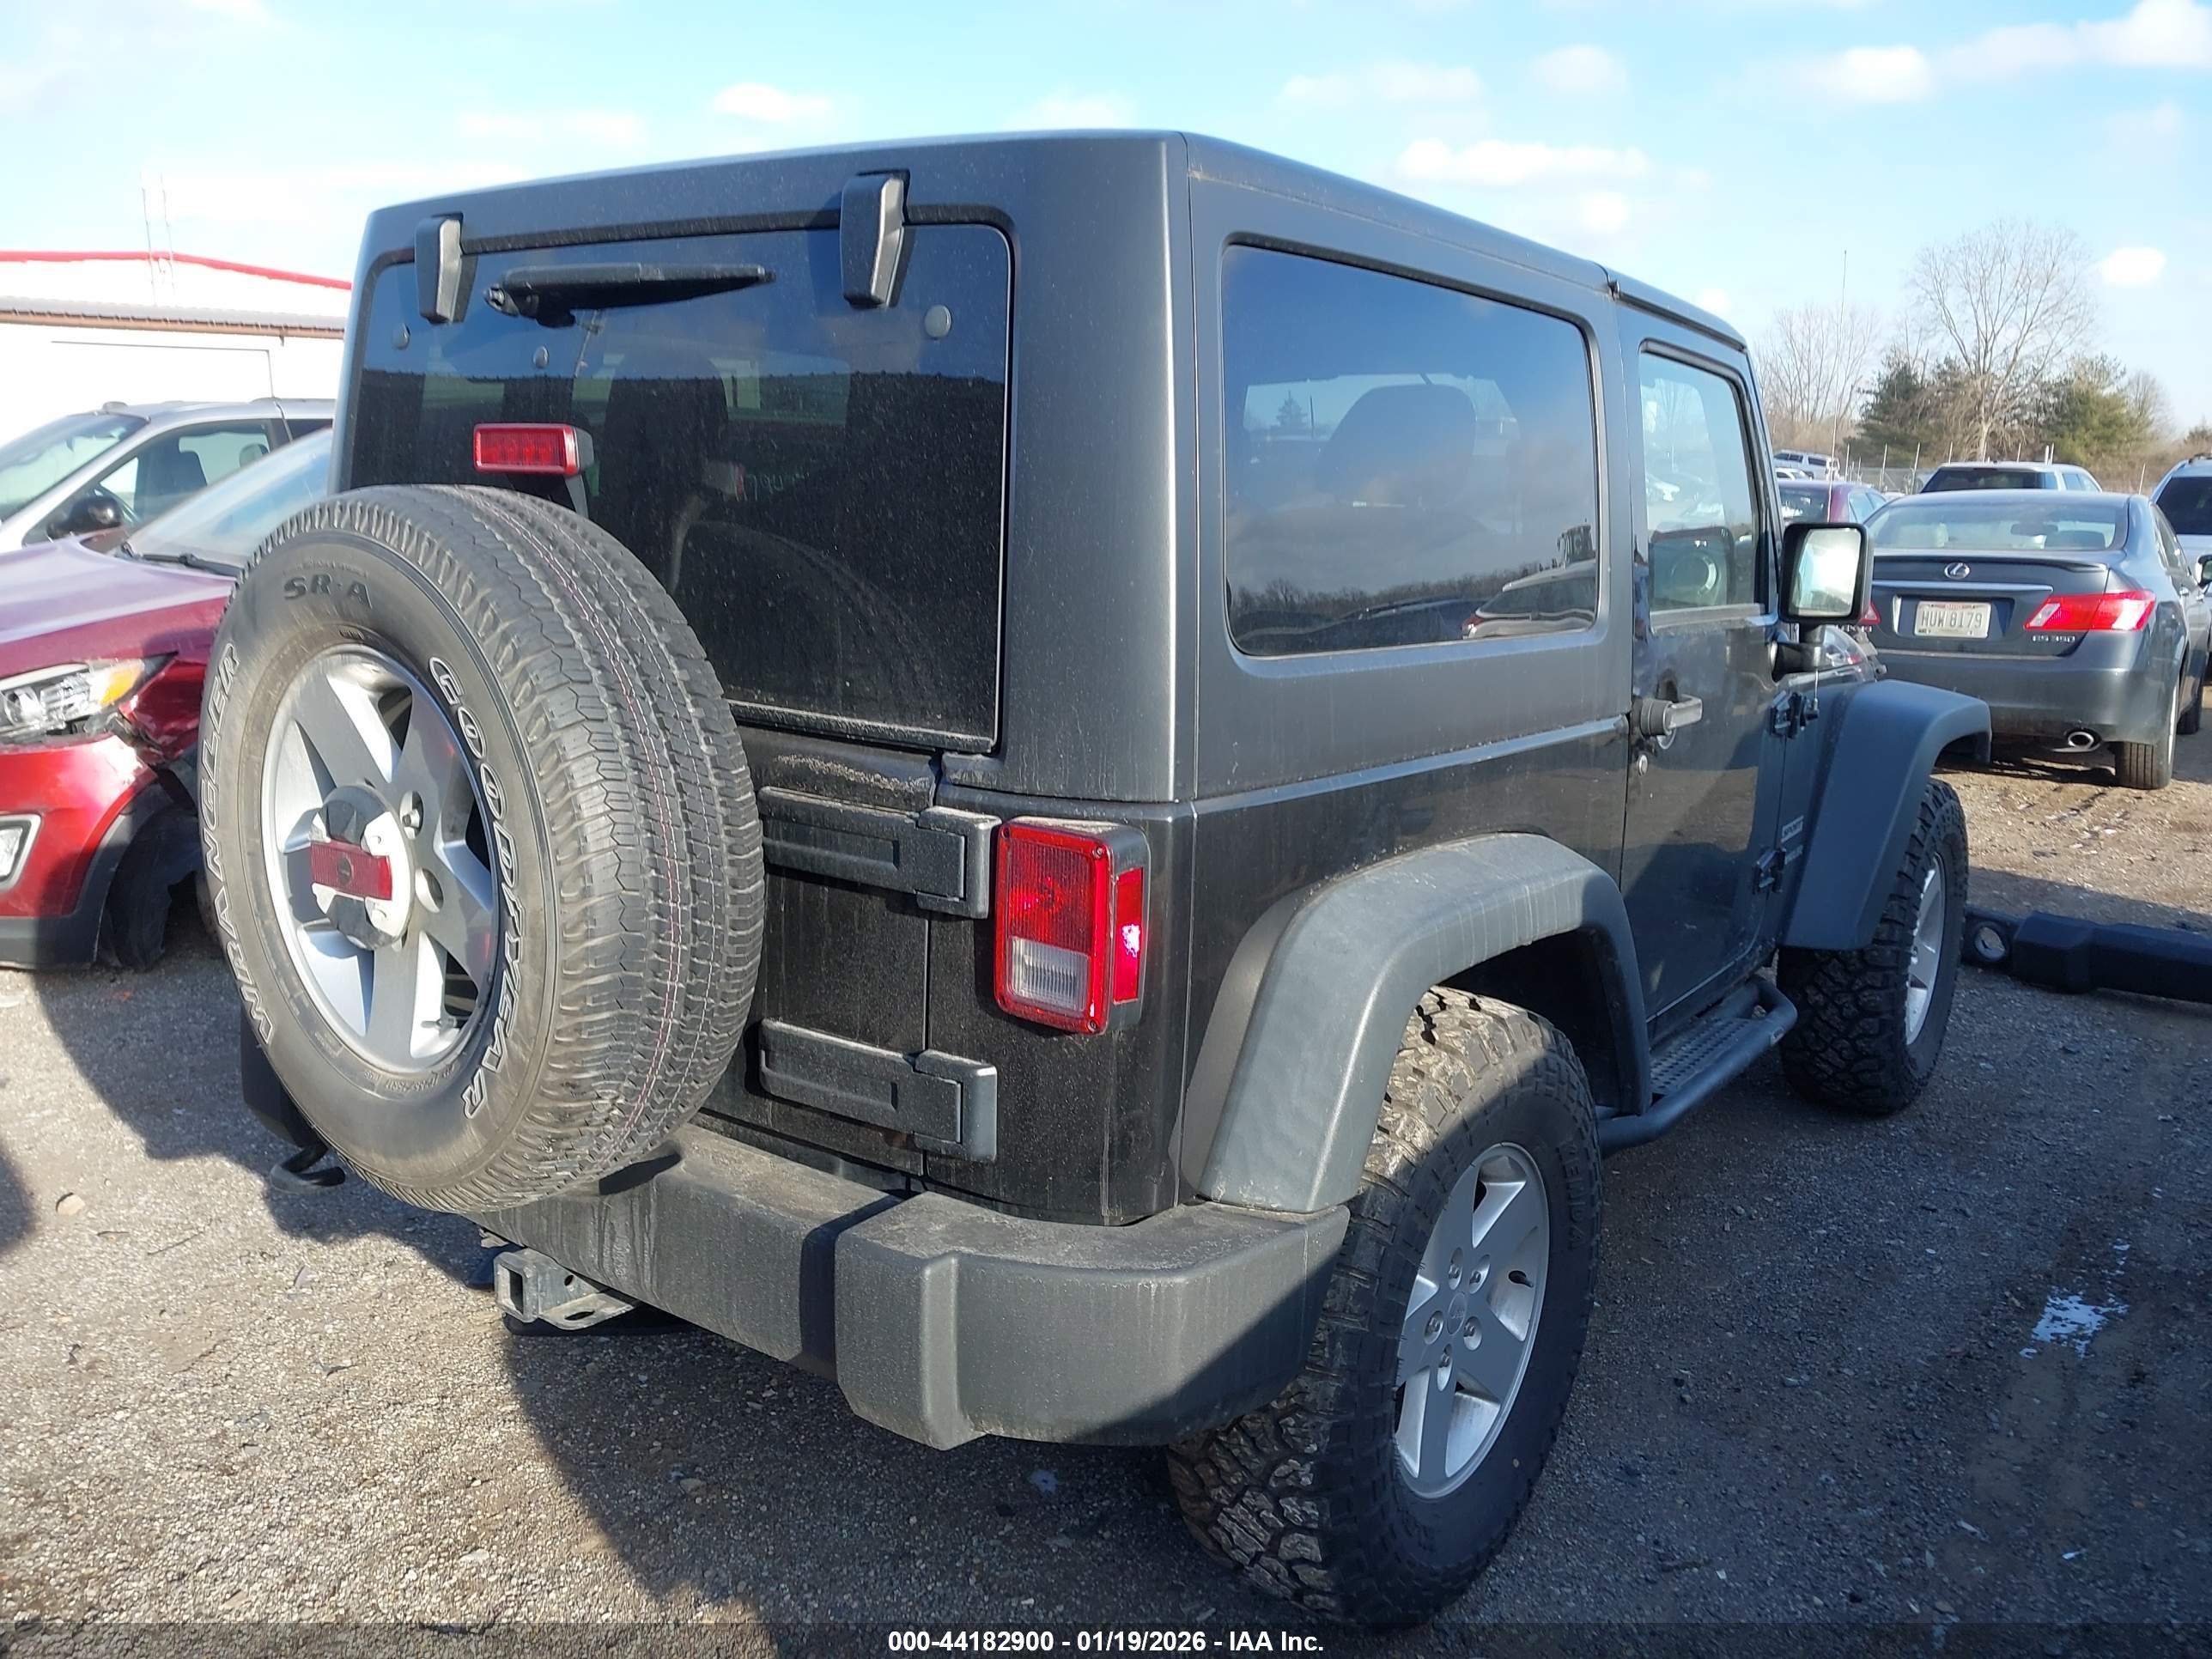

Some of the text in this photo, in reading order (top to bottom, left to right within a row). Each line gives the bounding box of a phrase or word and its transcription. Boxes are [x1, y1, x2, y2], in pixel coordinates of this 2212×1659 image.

[1949, 612, 1983, 629] 8179
[200, 642, 274, 1044] WRANGLER
[428, 656, 526, 1120] GOODYEAR
